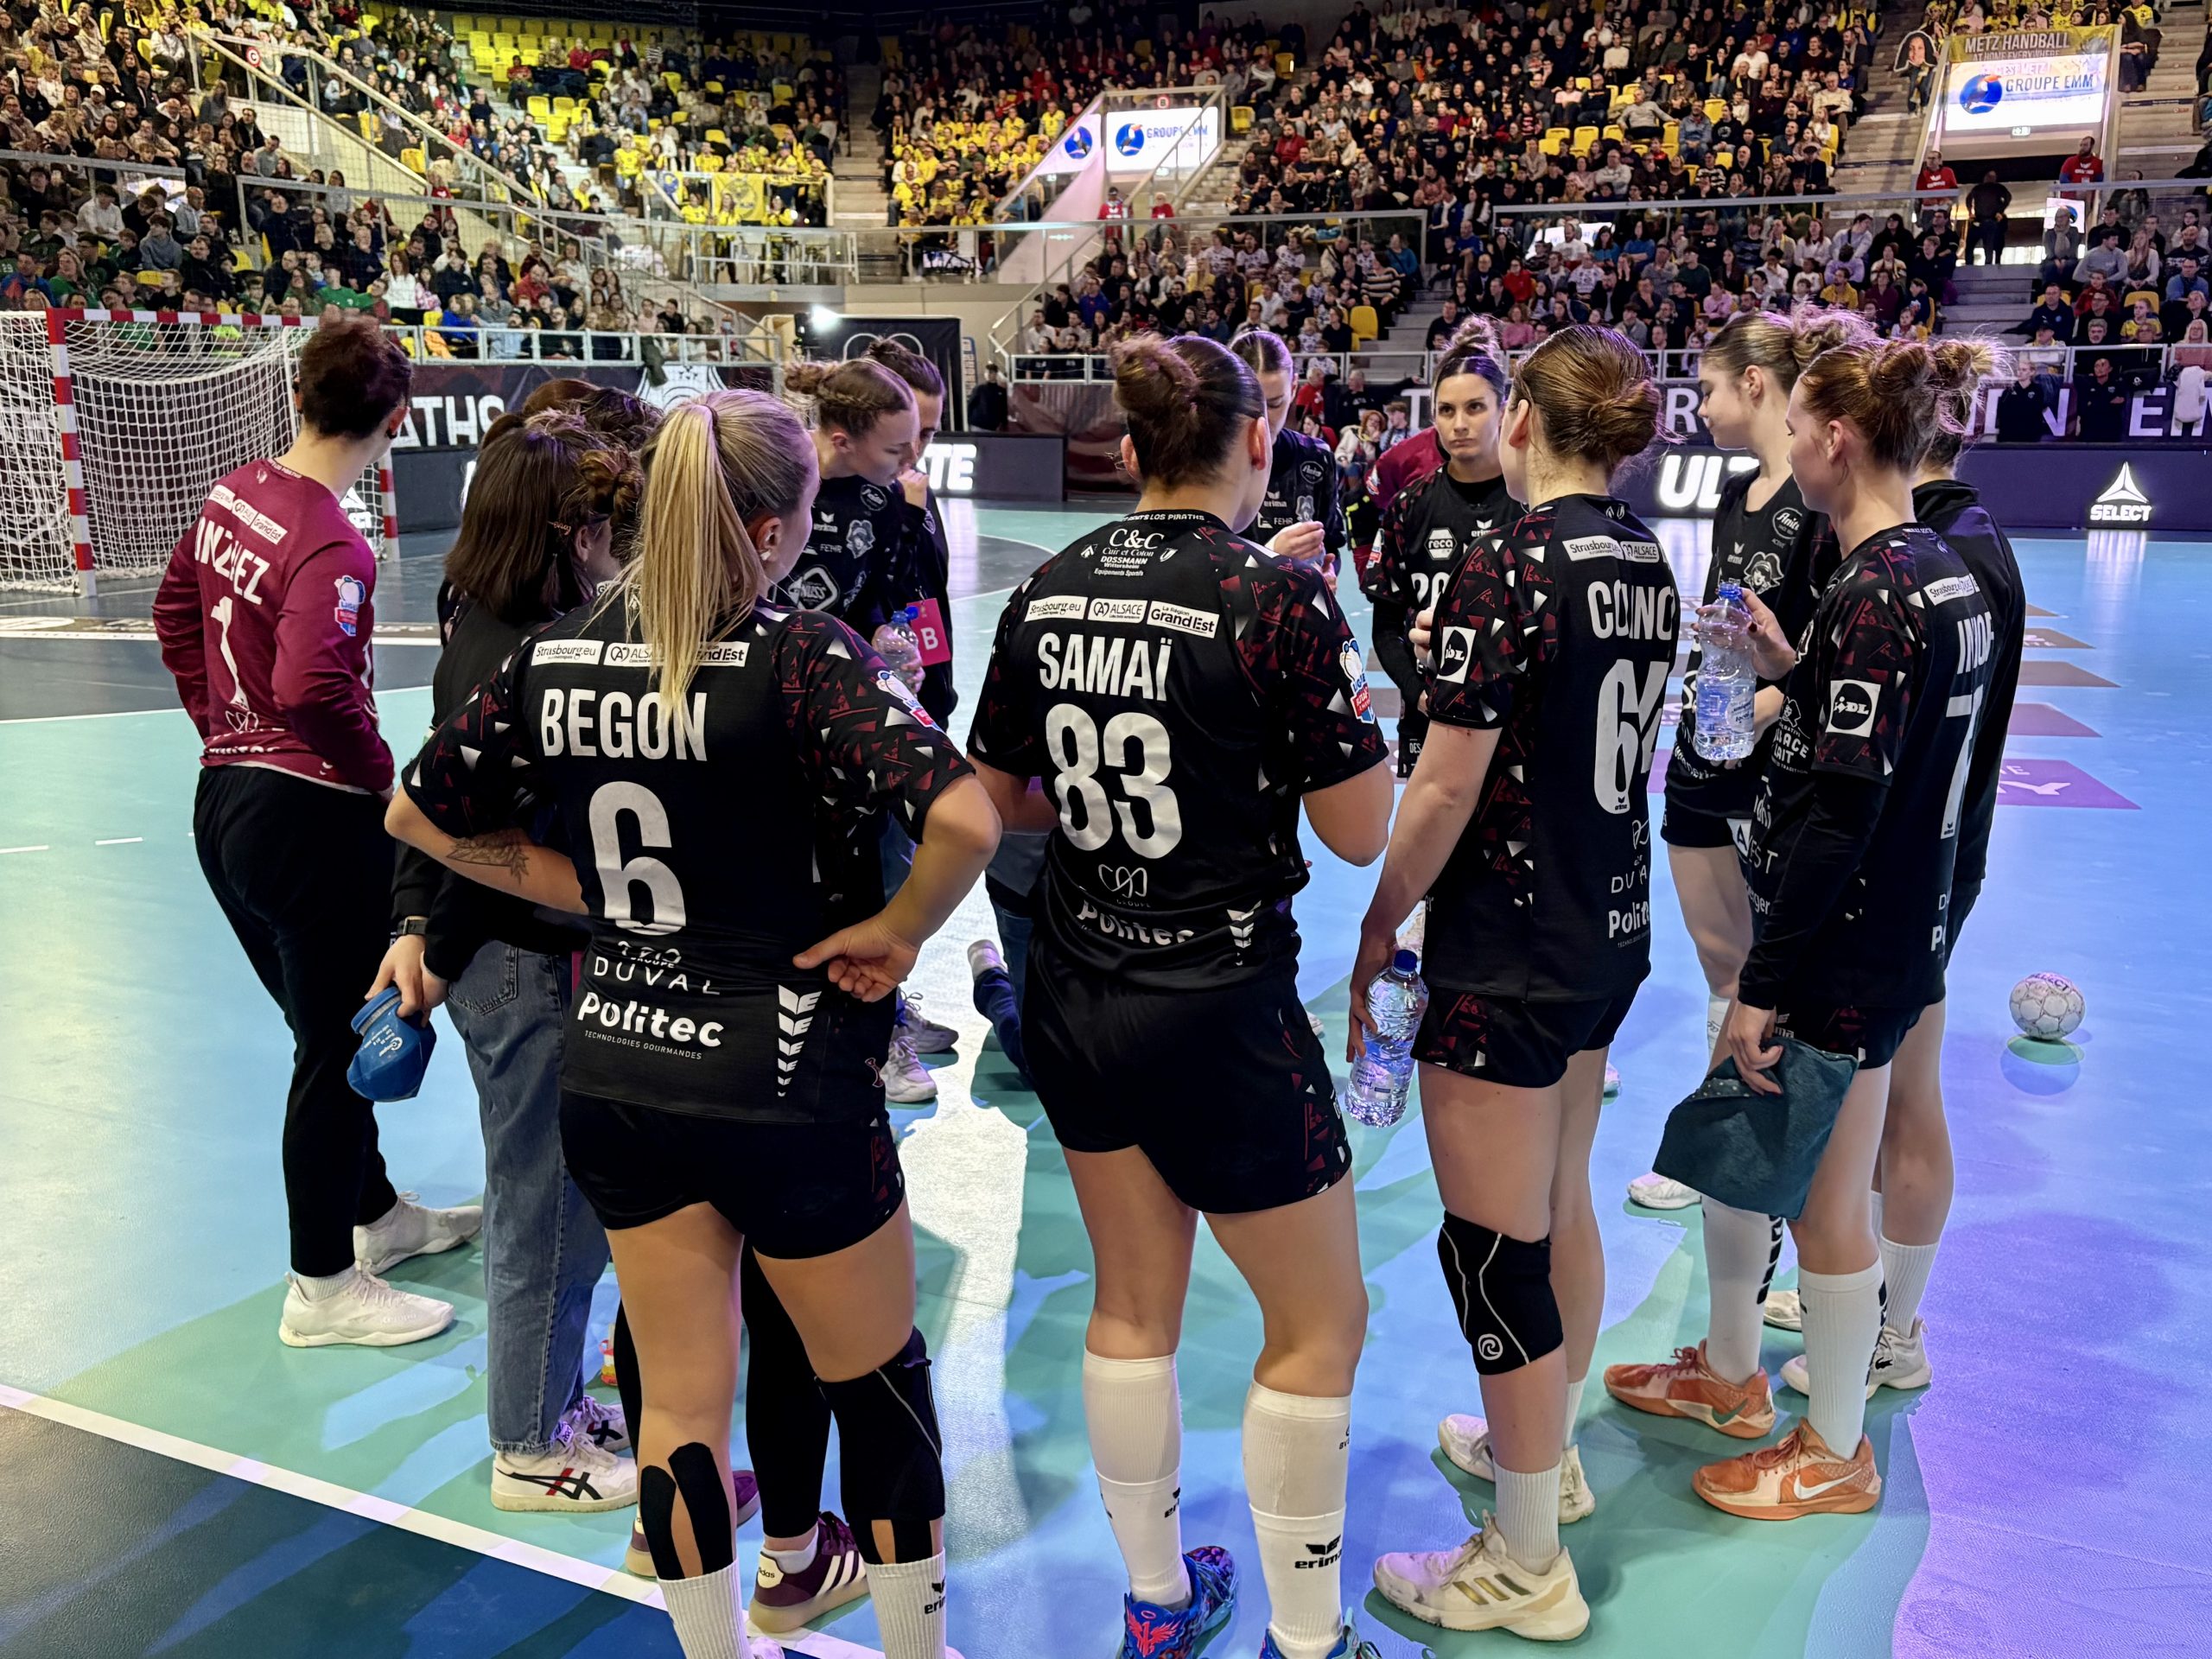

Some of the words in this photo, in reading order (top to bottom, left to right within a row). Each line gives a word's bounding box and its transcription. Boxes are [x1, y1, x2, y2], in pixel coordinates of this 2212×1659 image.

[1965, 37, 1999, 53] METZ
[2002, 33, 2069, 50] HANDBALL
[2005, 76, 2059, 92] GROUPE
[2064, 73, 2094, 88] EMM
[1274, 517, 1294, 525] FEHR
[2089, 504, 2152, 521] SELECT
[1109, 528, 1165, 550] C&C
[1427, 539, 1453, 549] reca
[1100, 556, 1148, 565] DOSSMANN
[1103, 547, 1119, 556] Cuir
[1130, 549, 1154, 557] Coton
[1633, 545, 1657, 556] ALSACE
[1110, 604, 1142, 616] ALSACE
[920, 626, 939, 650] B
[1038, 632, 1173, 702] SAMAÏ
[541, 689, 708, 761] BEGON
[1046, 702, 1182, 859] 83
[588, 780, 687, 938] 6
[594, 956, 721, 995] DUVAL
[576, 991, 725, 1048] Politec
[584, 1030, 641, 1049] TECHNOLOGIES
[643, 1041, 702, 1060] GOURMANDES
